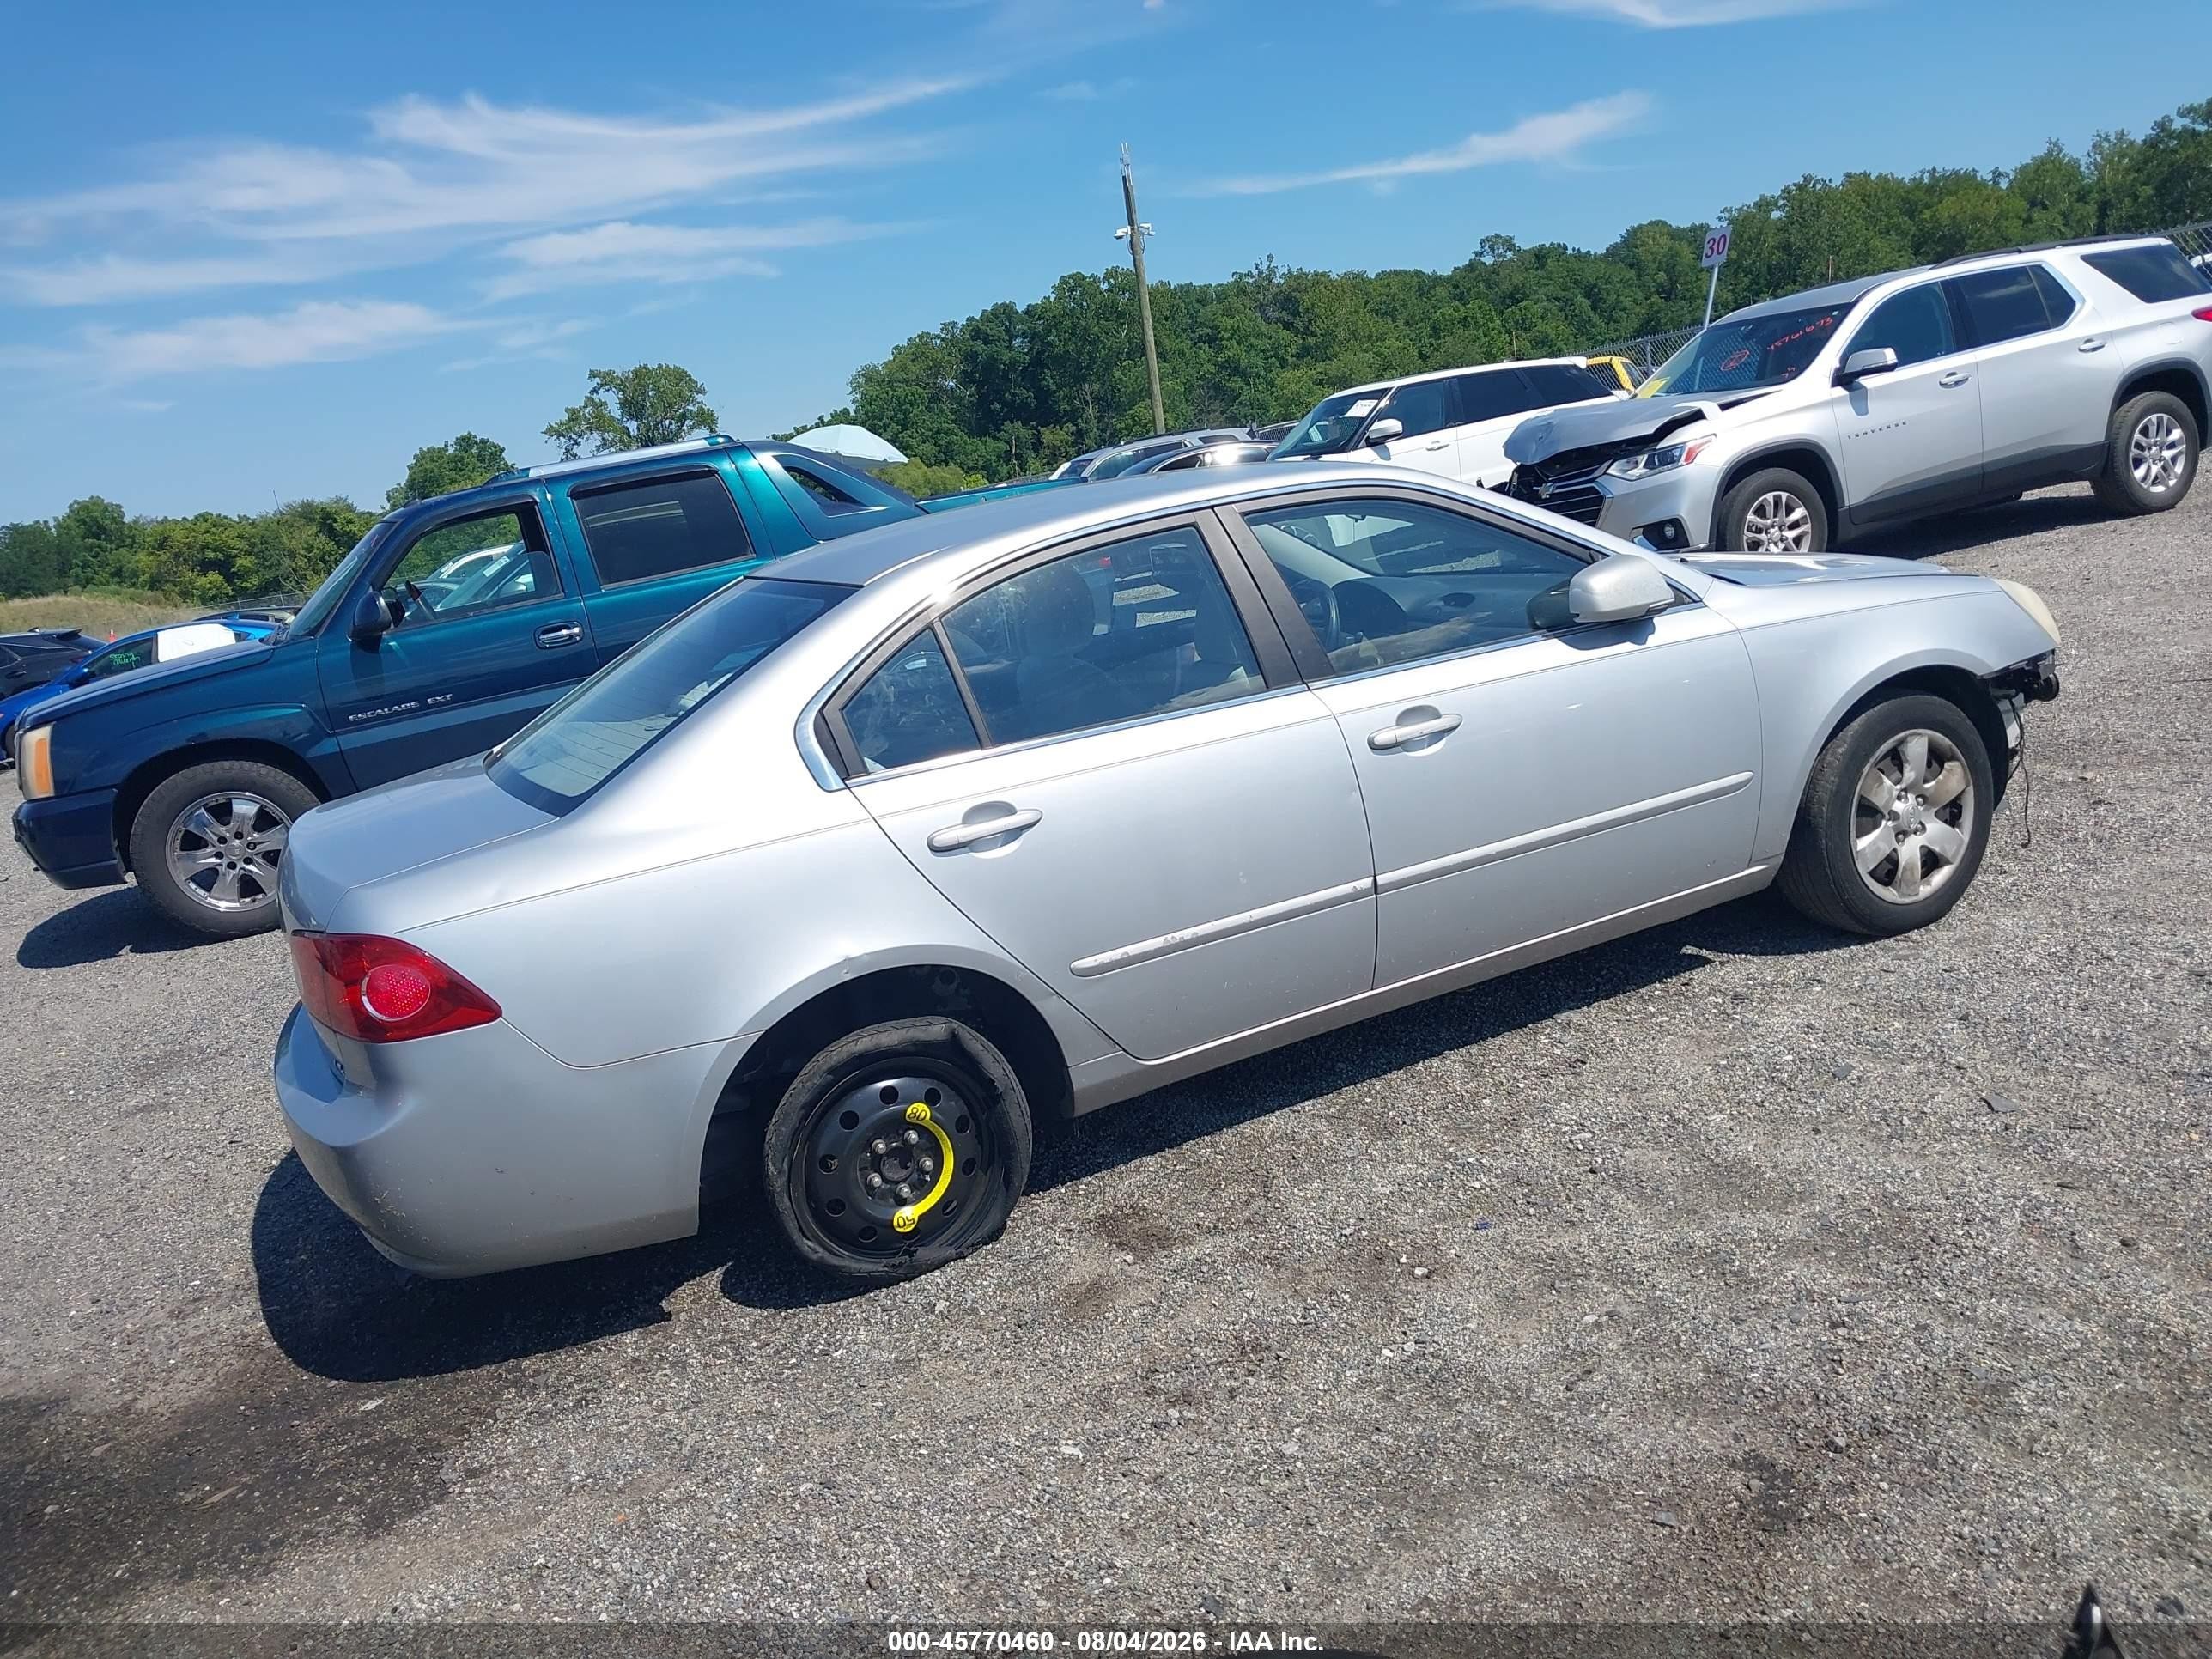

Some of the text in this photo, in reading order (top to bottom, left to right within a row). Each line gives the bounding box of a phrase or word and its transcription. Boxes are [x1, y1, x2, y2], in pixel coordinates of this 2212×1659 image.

[1705, 234, 1727, 258] 30
[349, 694, 453, 721] ESCALADE EXT
[907, 1107, 927, 1121] 80
